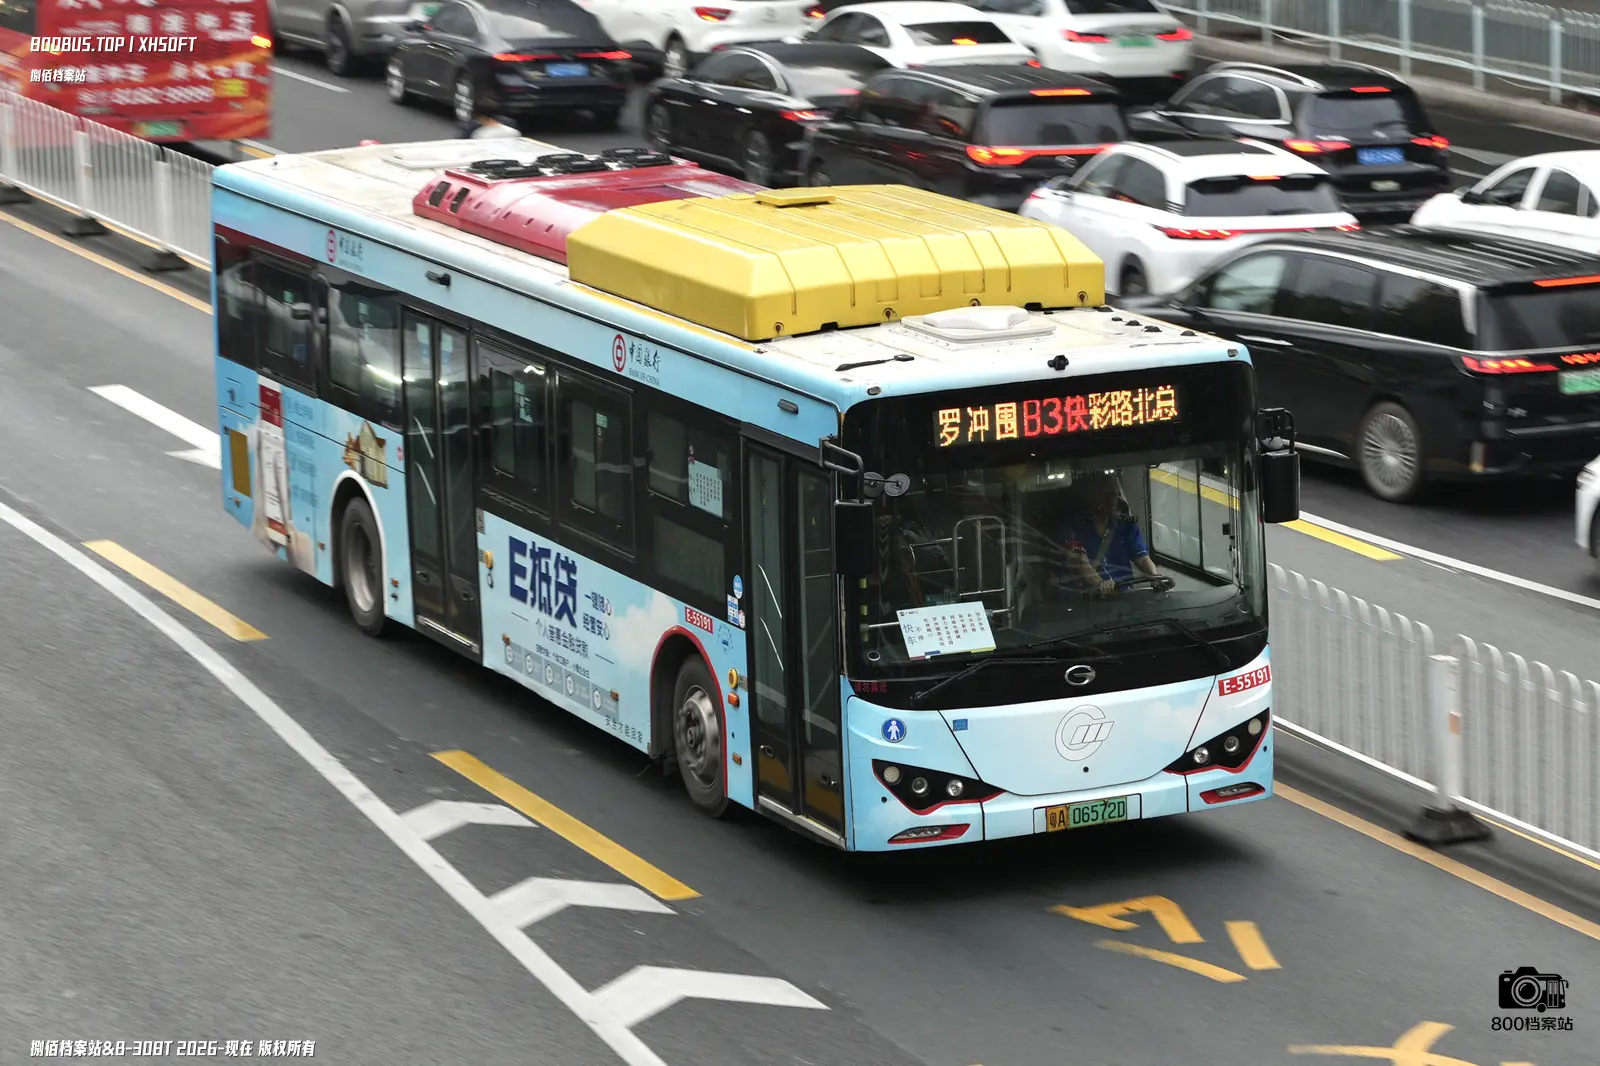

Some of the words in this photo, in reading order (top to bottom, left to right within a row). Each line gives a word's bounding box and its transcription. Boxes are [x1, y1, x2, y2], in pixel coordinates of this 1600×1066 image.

[508, 535, 577, 629] E抵贷
[686, 609, 712, 631] E-55191
[1223, 667, 1269, 694] E-55191
